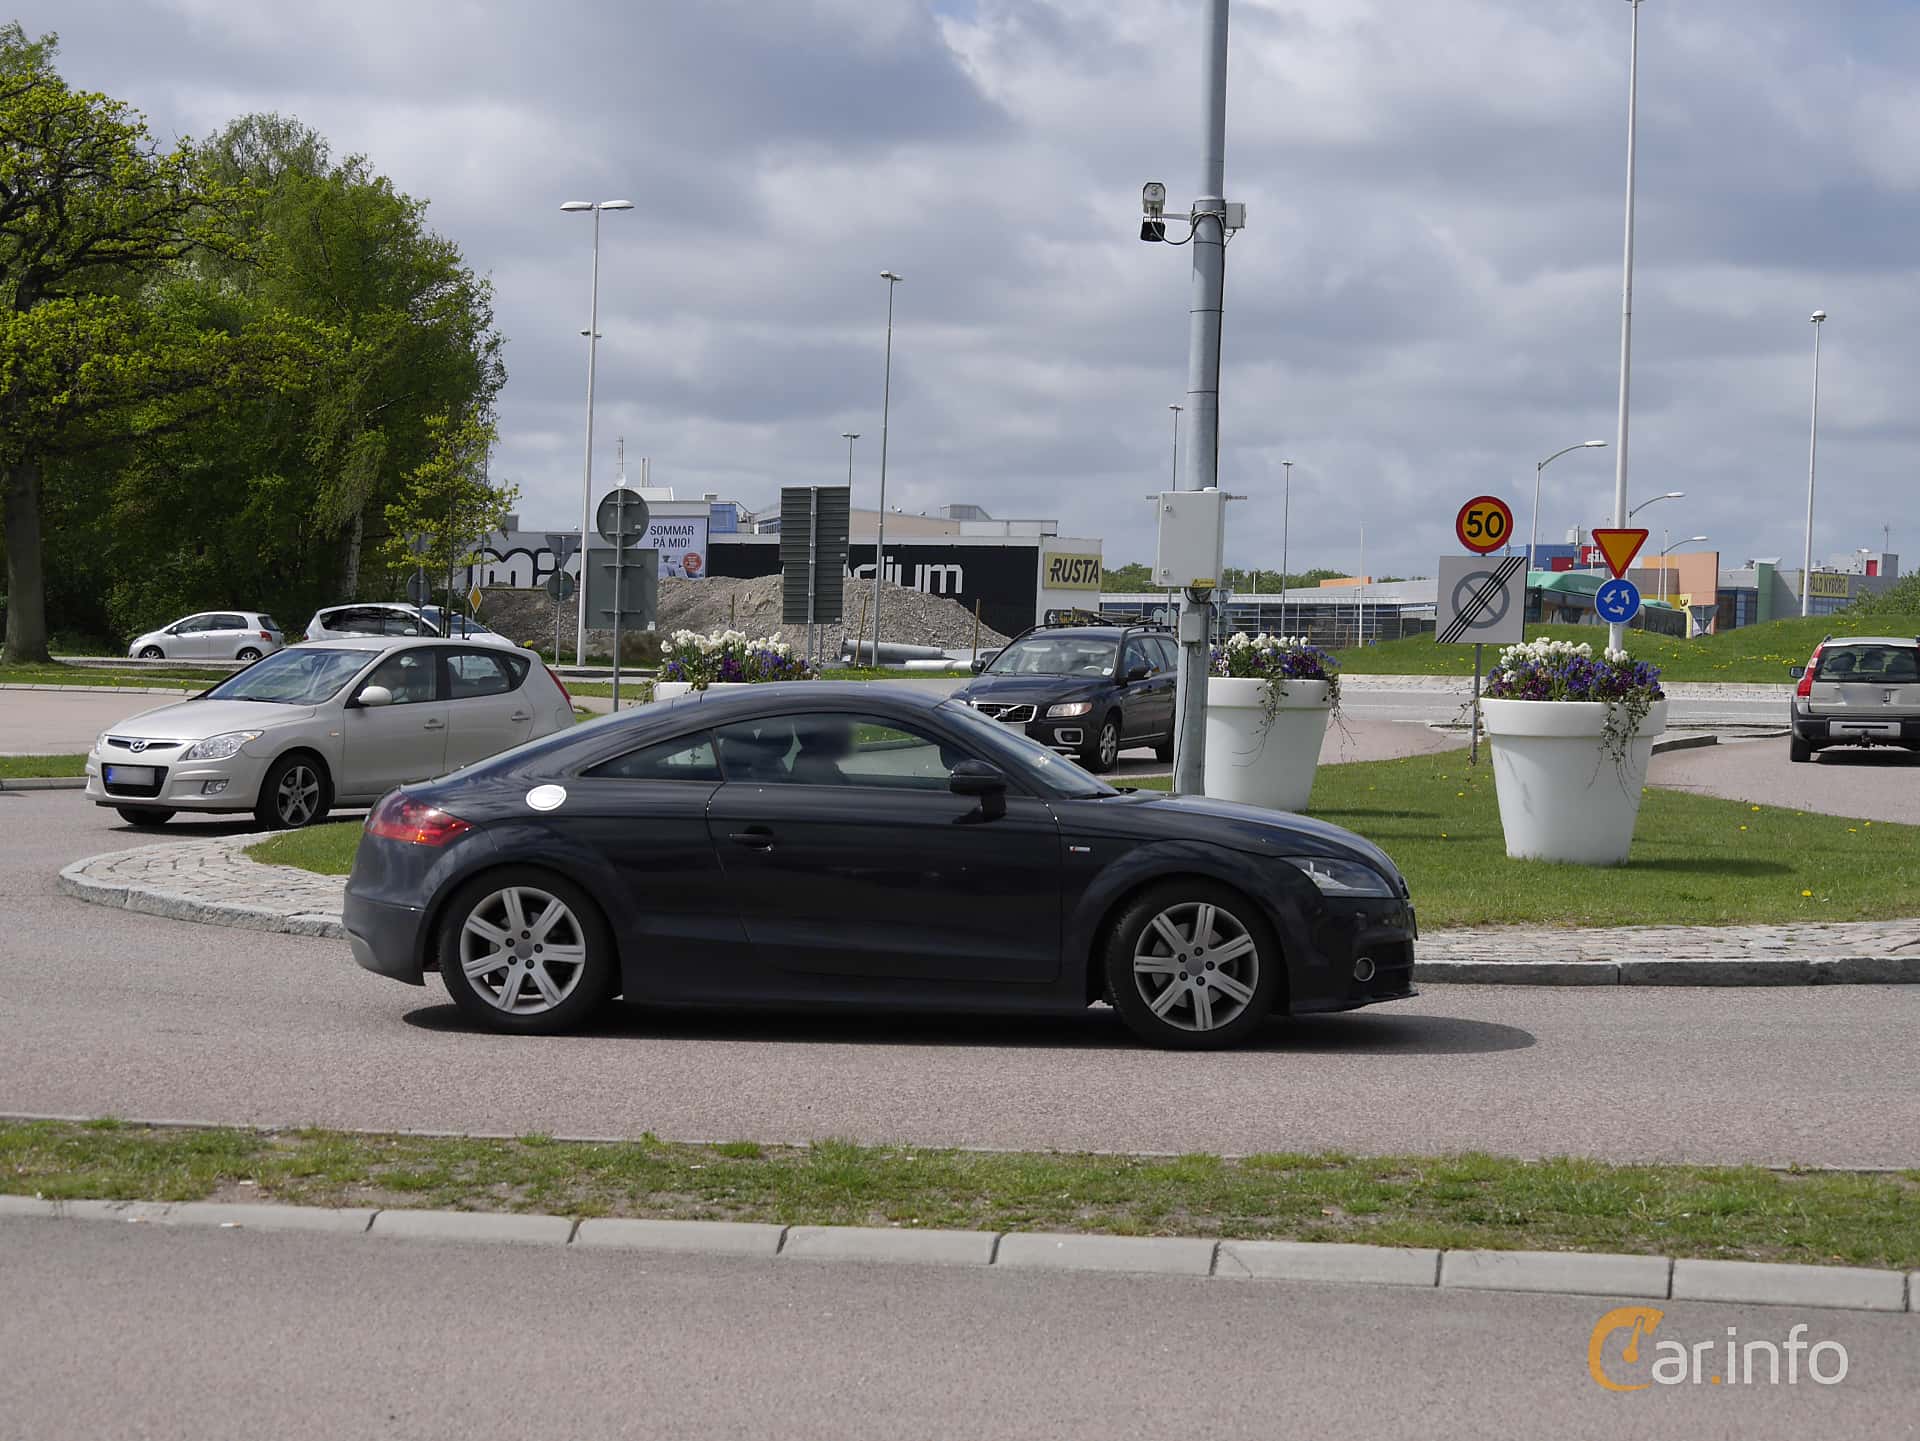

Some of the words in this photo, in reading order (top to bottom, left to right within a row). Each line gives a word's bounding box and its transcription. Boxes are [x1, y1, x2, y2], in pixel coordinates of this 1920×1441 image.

[650, 525, 695, 536] SOMMAR
[1466, 510, 1504, 538] 50
[653, 536, 666, 548] PÅ
[668, 537, 690, 548] MIO!
[1050, 558, 1099, 584] RUSTA
